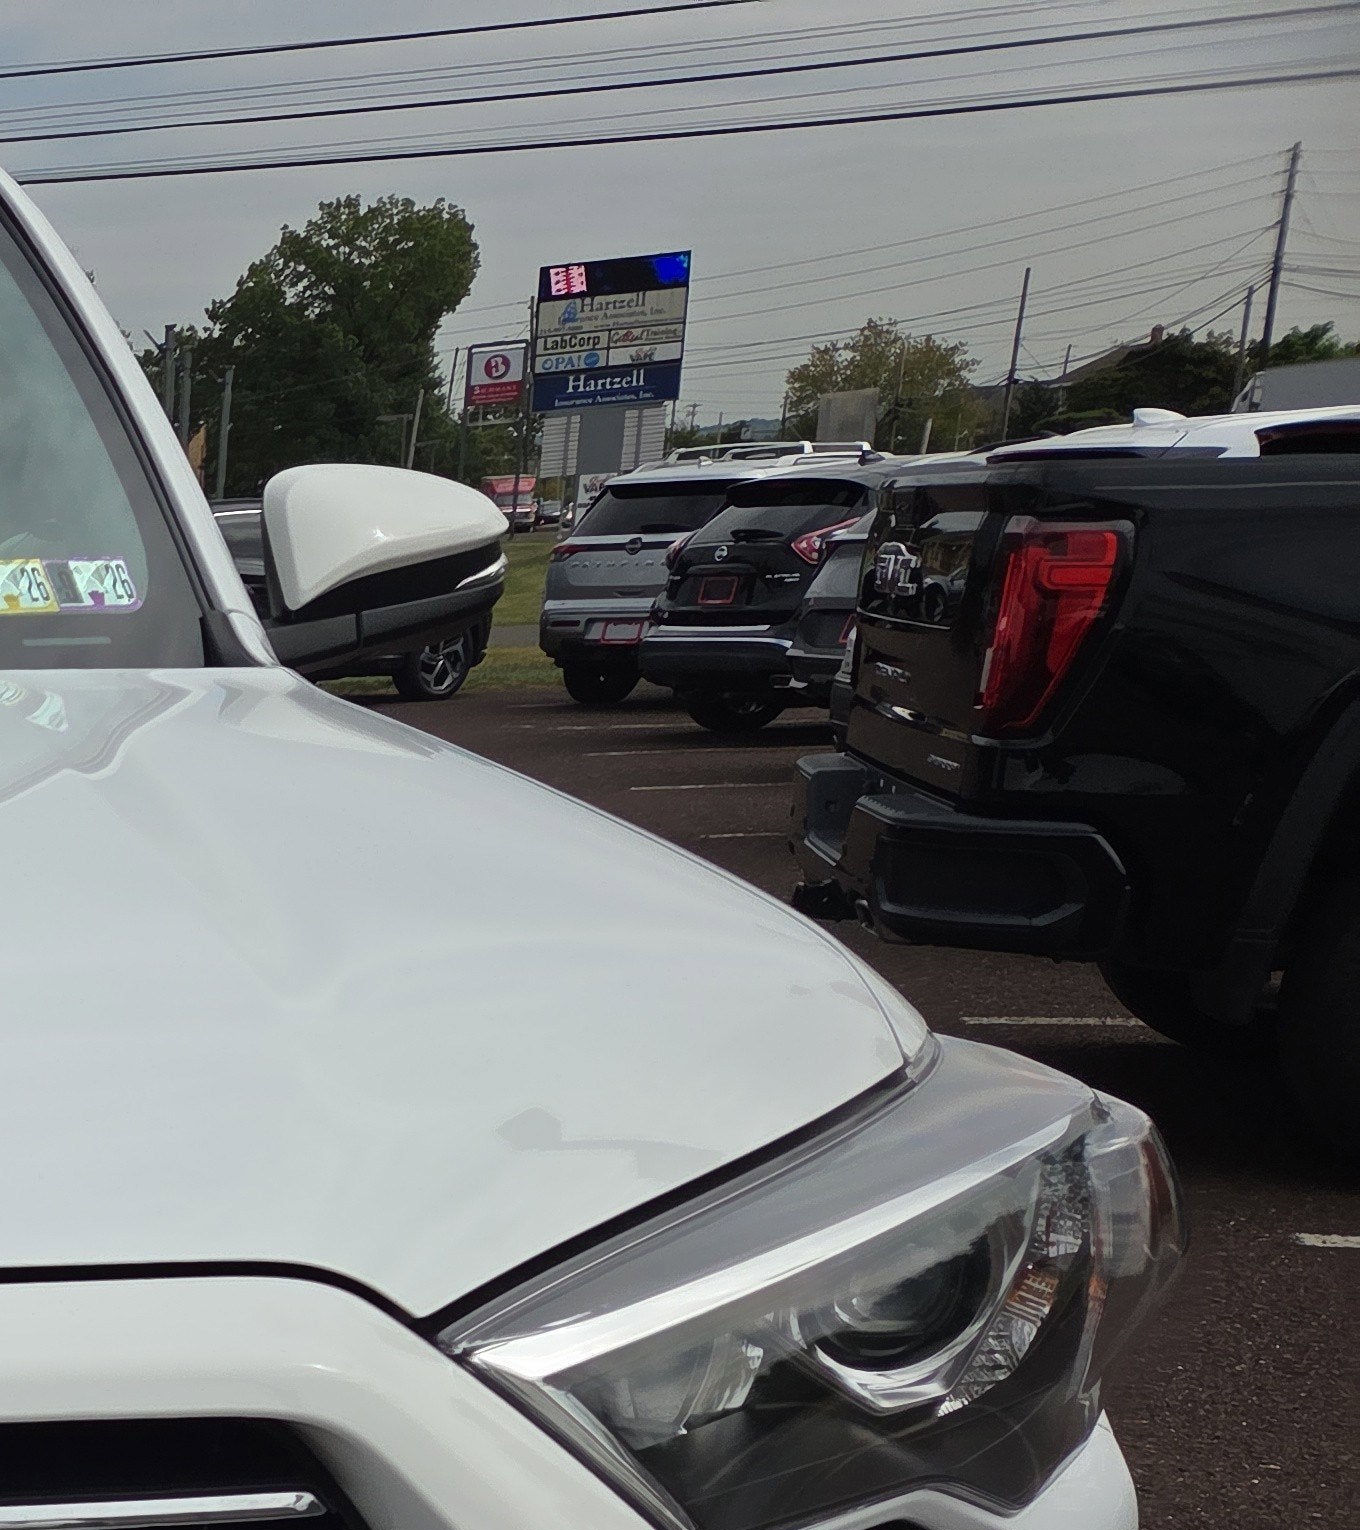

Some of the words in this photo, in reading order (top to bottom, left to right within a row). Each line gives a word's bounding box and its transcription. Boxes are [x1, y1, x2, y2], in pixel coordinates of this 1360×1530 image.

[580, 290, 646, 313] Hartzell
[543, 334, 600, 352] LabCorp
[566, 368, 645, 394] Hartzell
[20, 566, 50, 602] 26
[104, 563, 134, 600] 26
